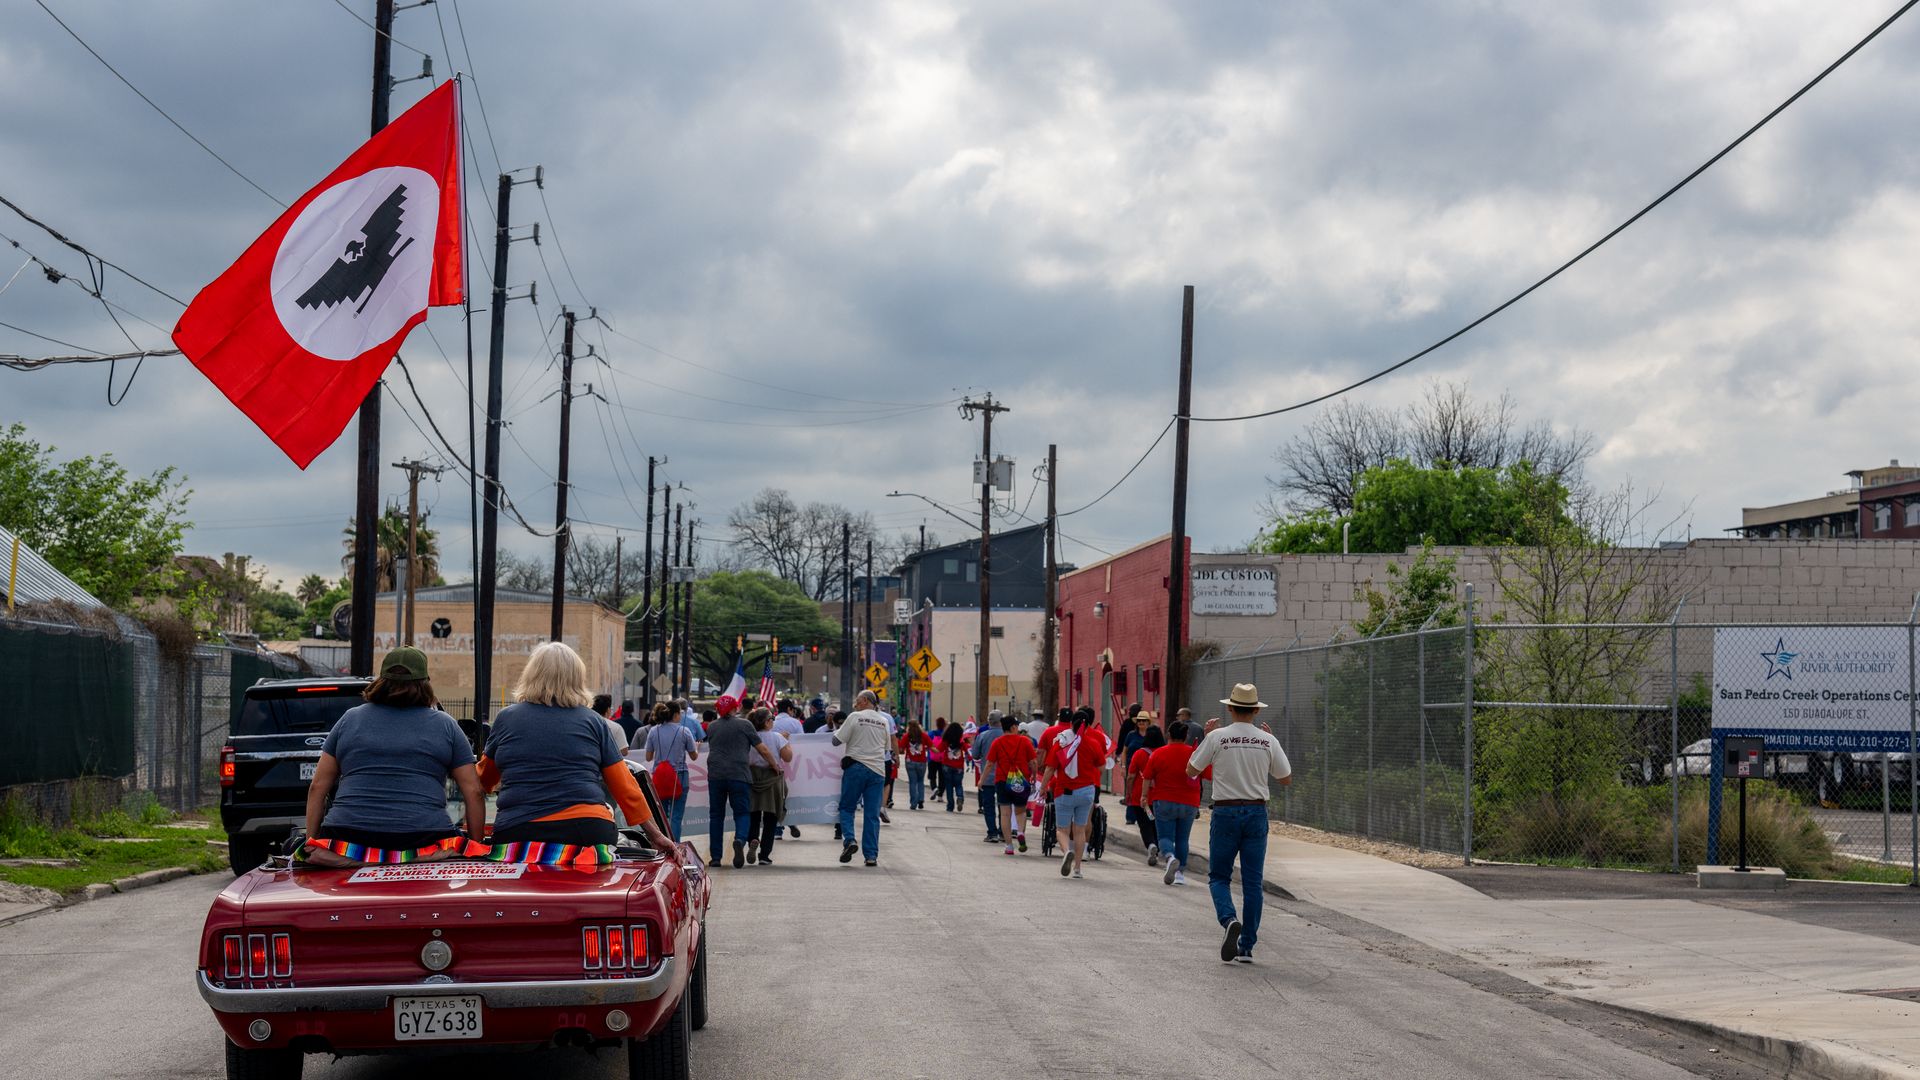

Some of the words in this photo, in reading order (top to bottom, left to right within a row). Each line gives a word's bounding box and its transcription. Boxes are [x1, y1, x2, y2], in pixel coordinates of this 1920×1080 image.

[1221, 570, 1274, 581] CUSTOM
[1833, 651, 1896, 660] ANTONIO
[1801, 662, 1830, 673] RIVER
[1833, 662, 1896, 673] AUTHORITY
[1720, 688, 1742, 700] San
[1744, 688, 1780, 700] Pedro
[1782, 689, 1819, 701] Creek
[1821, 689, 1891, 703] Operations
[1803, 708, 1853, 719] GUADALUPE
[1856, 709, 1870, 720] ST.
[1803, 735, 1835, 746] PLEASE
[1837, 736, 1858, 747] CALL
[357, 871, 378, 879] DR.
[383, 869, 433, 878] DANIEL
[330, 910, 540, 921] MUSTANG
[401, 1001, 410, 1010] 19
[420, 1000, 456, 1009] TEXAS
[465, 999, 477, 1008] 67
